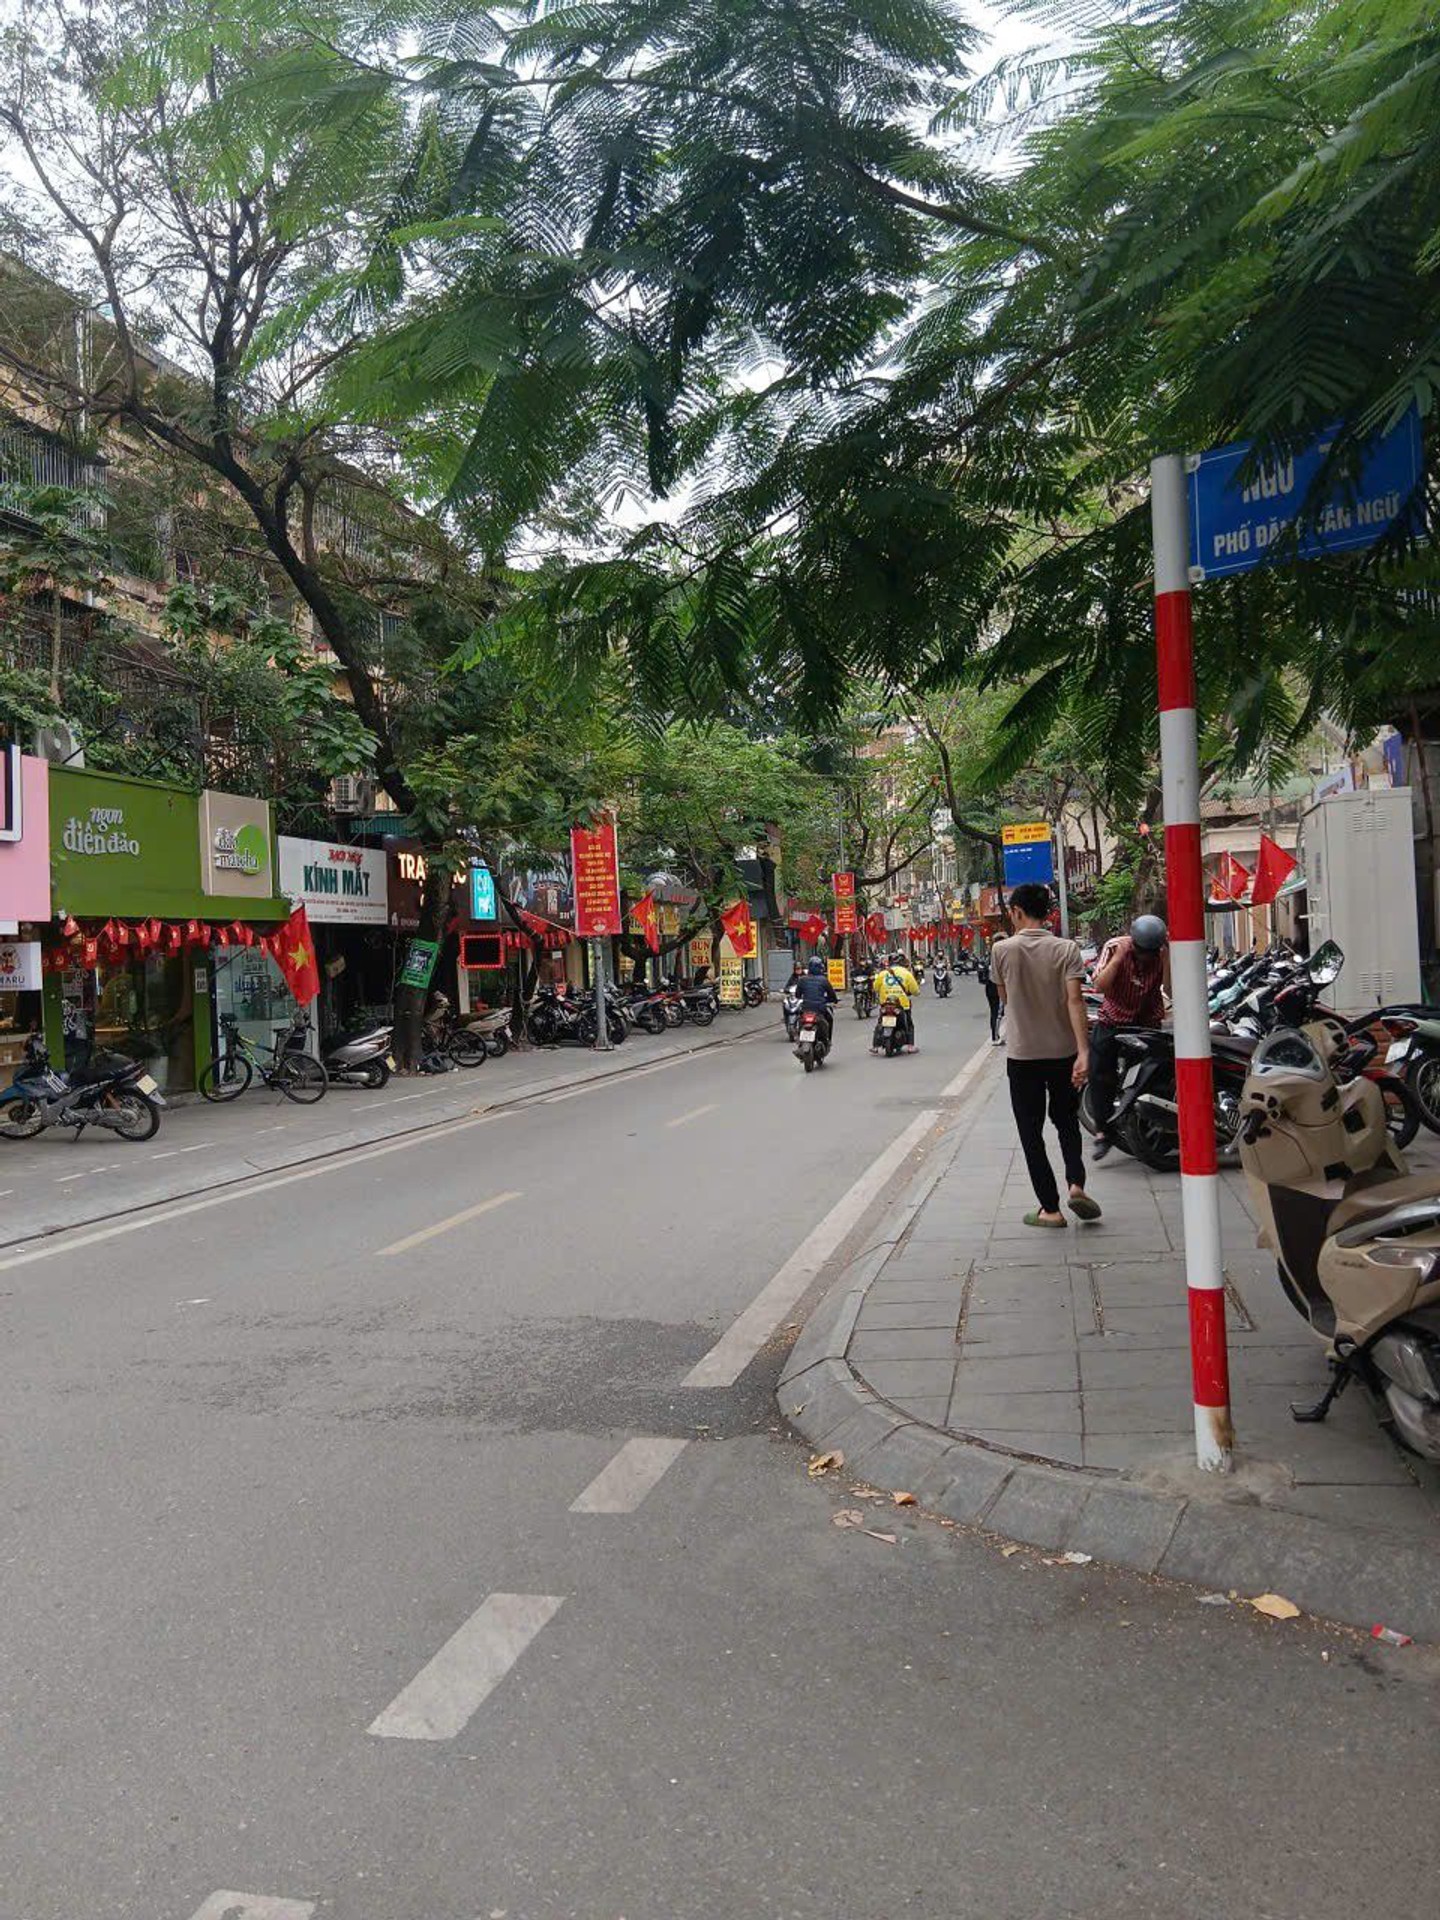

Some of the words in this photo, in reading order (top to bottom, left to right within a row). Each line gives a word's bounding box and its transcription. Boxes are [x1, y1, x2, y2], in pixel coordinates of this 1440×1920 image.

[1213, 520, 1250, 557] PHỐ
[303, 861, 338, 894] KÍNH
[342, 864, 370, 896] MẮT
